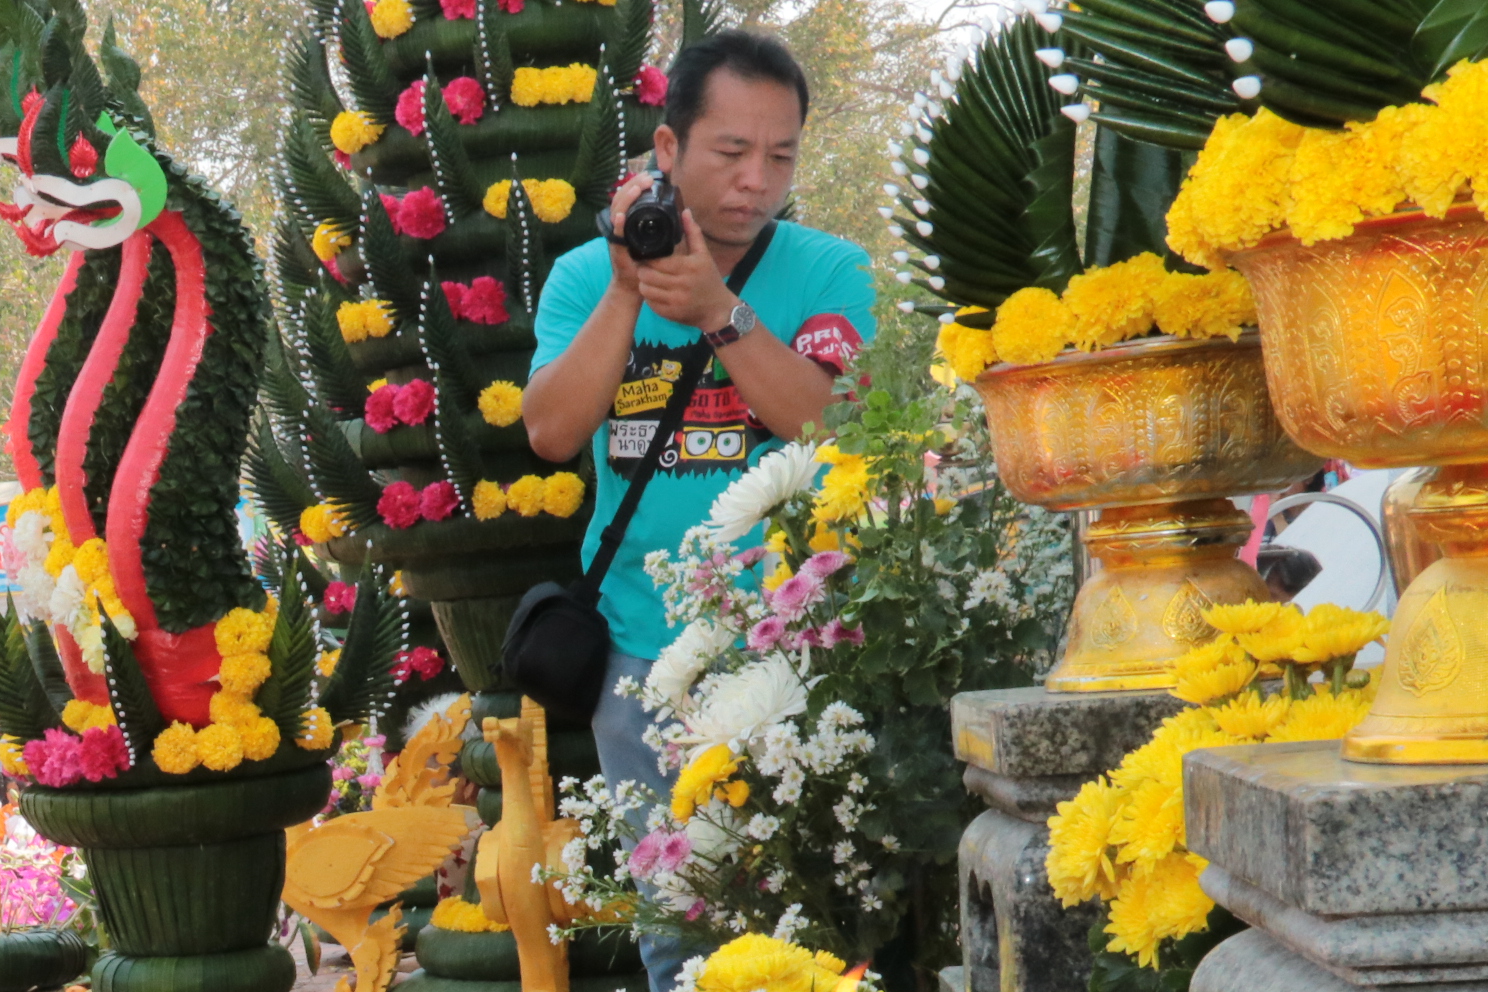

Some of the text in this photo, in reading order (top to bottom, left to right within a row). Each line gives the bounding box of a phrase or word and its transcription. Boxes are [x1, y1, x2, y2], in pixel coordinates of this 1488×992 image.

[622, 381, 659, 398] Maha
[616, 393, 667, 410] Sarakham
[610, 423, 658, 437] พระธา
[618, 438, 652, 455] นาดู
